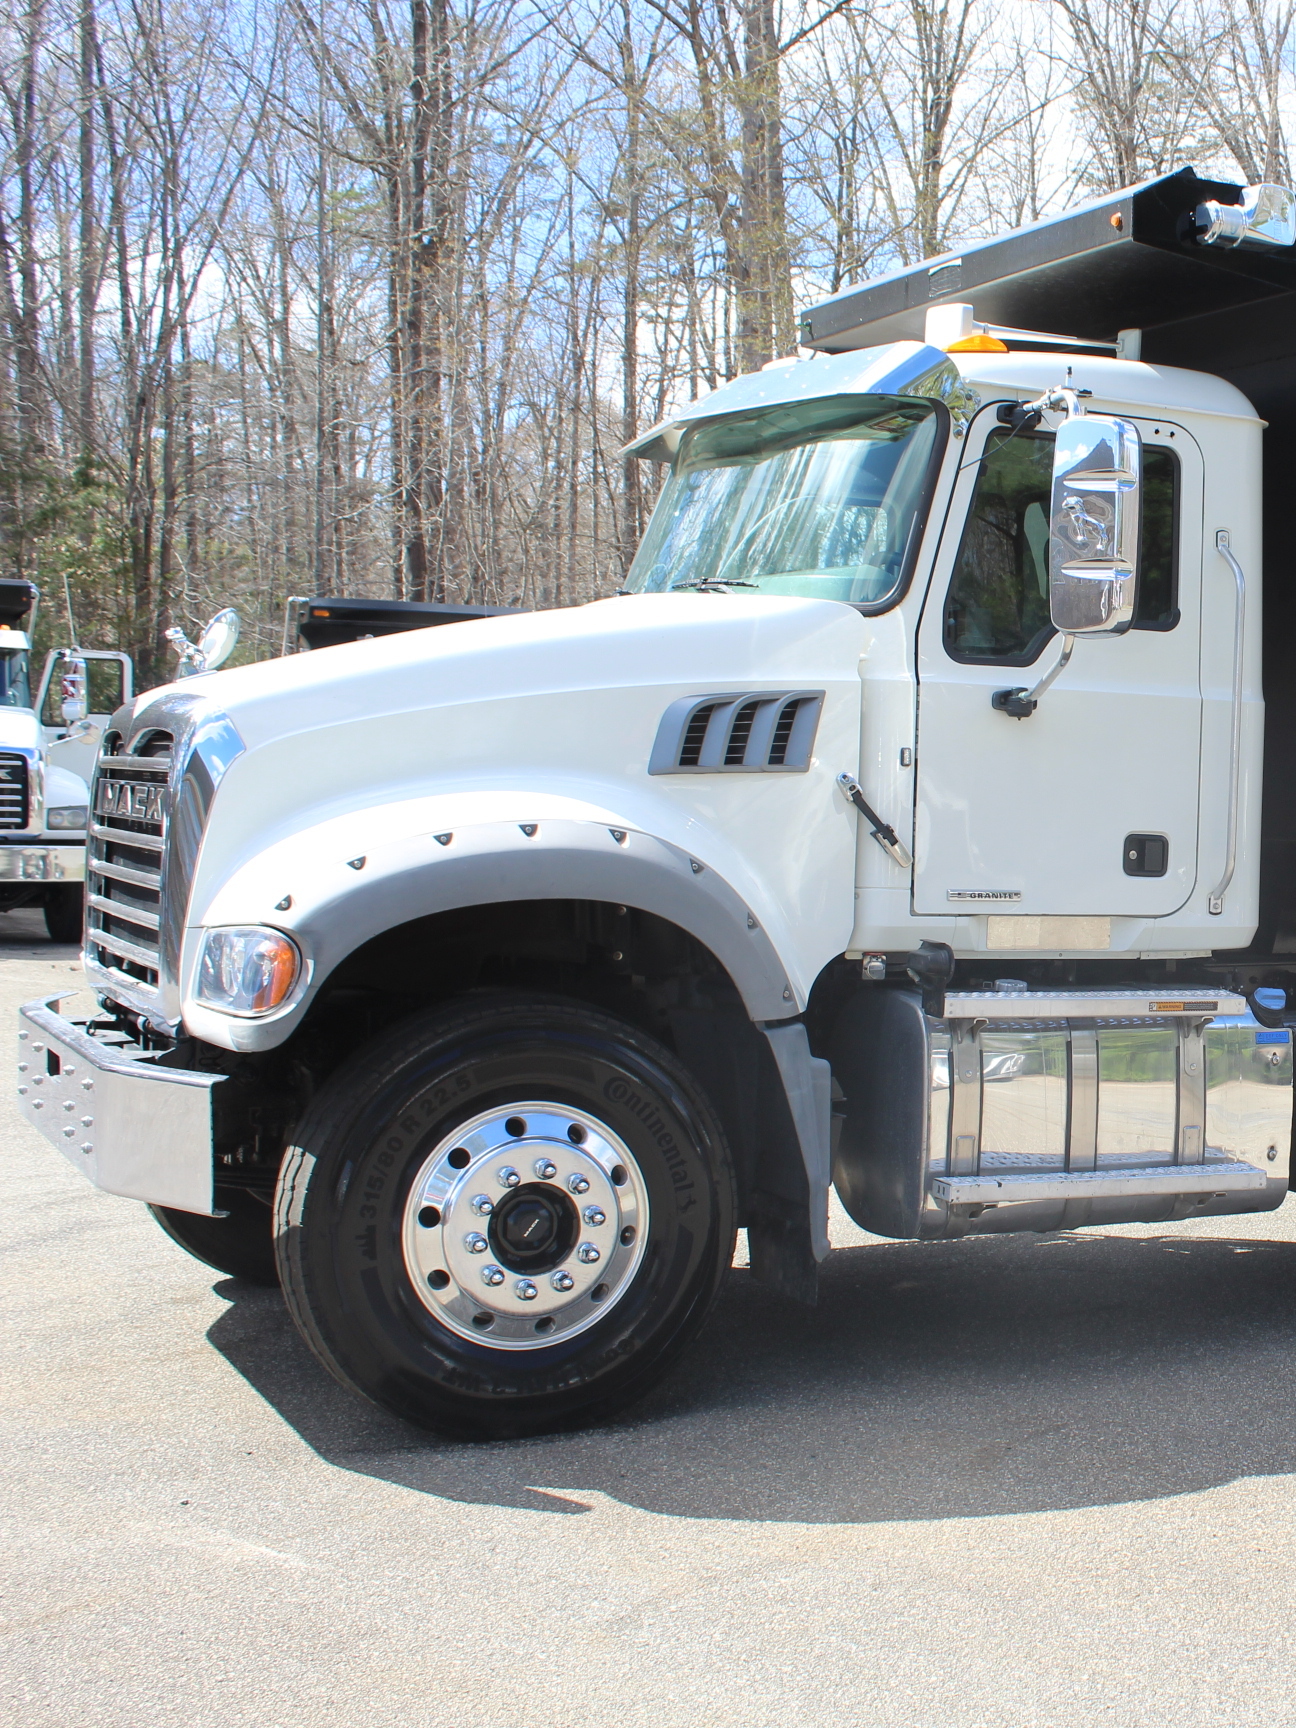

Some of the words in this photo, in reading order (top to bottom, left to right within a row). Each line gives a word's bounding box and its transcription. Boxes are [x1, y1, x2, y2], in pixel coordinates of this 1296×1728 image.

[102, 783, 165, 821] MACK
[359, 1136, 404, 1219] 315/80
[399, 1115, 421, 1135] R
[420, 1074, 471, 1117] 22.5
[603, 1076, 695, 1193] Continental
